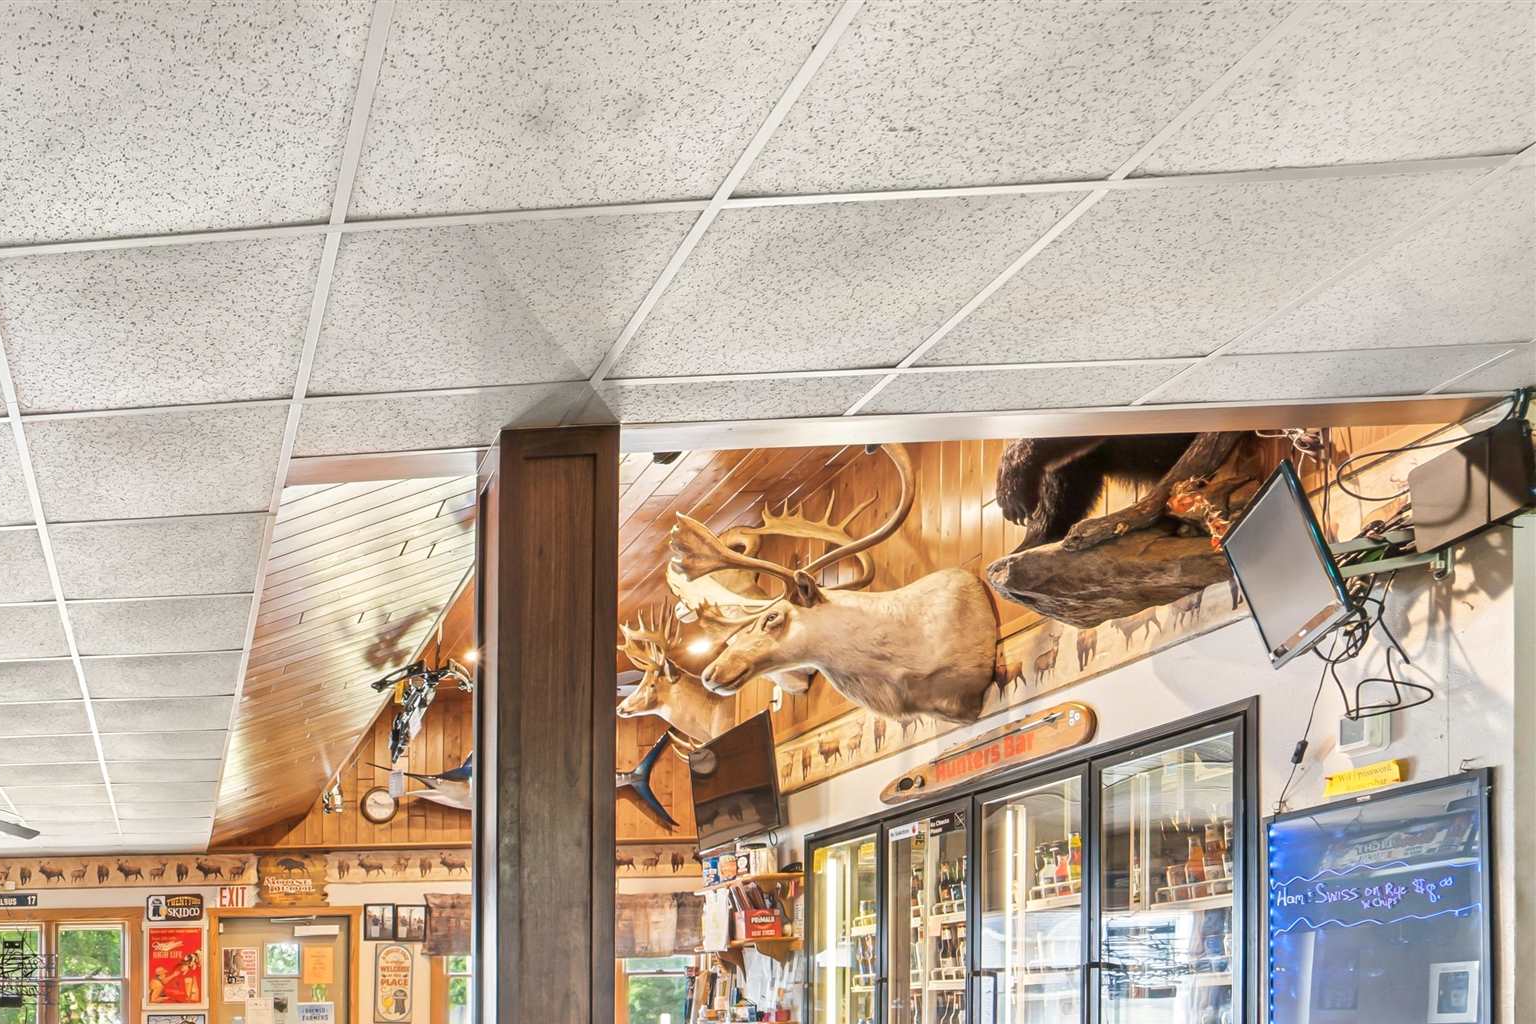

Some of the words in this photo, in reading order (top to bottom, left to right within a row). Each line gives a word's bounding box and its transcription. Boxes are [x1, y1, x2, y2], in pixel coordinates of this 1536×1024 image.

[936, 743, 1000, 782] Hunters
[1004, 731, 1034, 758] Bar
[27, 896, 36, 905] 17
[219, 886, 247, 907] EXIT
[1277, 887, 1305, 906] Ham
[1315, 883, 1360, 904] Swiss
[1364, 888, 1380, 897] on
[1384, 884, 1408, 903] Rye
[167, 907, 200, 918] SKIDOO
[380, 978, 409, 986] PLACE
